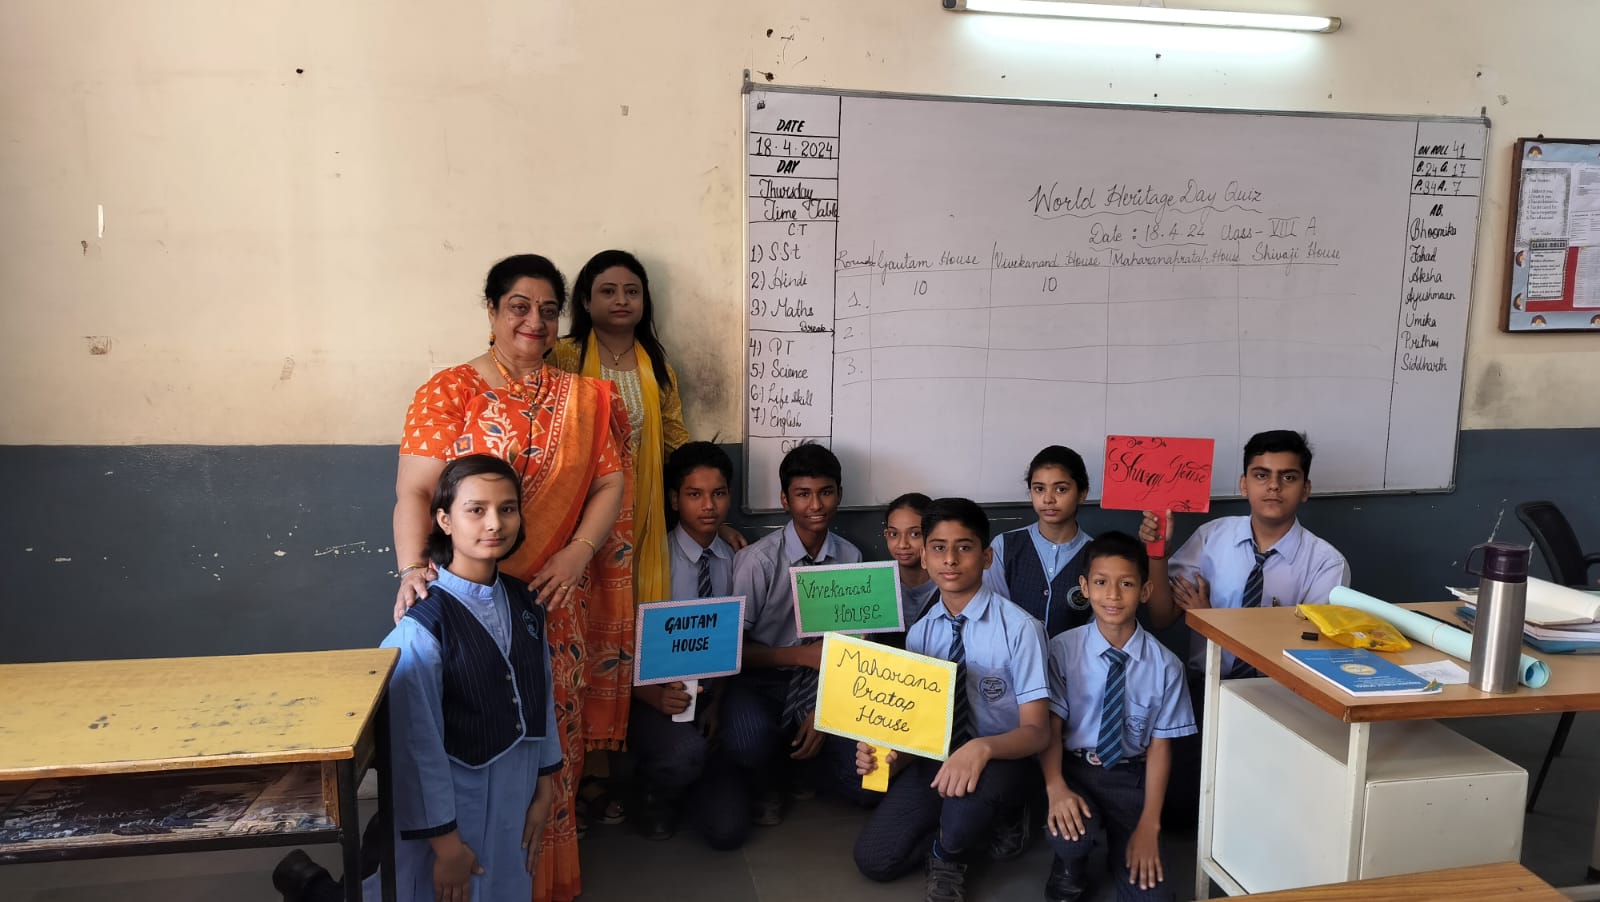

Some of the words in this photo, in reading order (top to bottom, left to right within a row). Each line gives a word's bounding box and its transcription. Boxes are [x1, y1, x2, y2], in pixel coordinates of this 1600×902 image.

[776, 119, 806, 133] DATE
[1418, 145, 1430, 155] ON
[1431, 145, 1449, 155] ROLL
[1453, 140, 1466, 159] 41
[776, 160, 800, 174] DAY
[1452, 163, 1466, 177] 17
[759, 178, 814, 207] Thursday
[1453, 181, 1462, 196] 7
[764, 199, 798, 221] Time
[808, 200, 839, 219] Table
[1028, 182, 1097, 214] World
[1104, 183, 1177, 225] Heritage
[1180, 179, 1217, 225] Day
[1224, 181, 1263, 202] Quiz
[1089, 222, 1123, 245] Date
[1268, 216, 1301, 239] VIII
[1305, 216, 1317, 236] A
[877, 250, 932, 286] Gautam
[939, 250, 980, 266] House
[995, 249, 1058, 269] Vivekanand
[1064, 252, 1101, 267] House
[1252, 242, 1299, 276] Shivaji
[1307, 241, 1341, 260] House
[768, 267, 808, 289] Hindi
[913, 279, 928, 296] 10
[1042, 276, 1058, 293] 10
[771, 297, 814, 317] Maths
[799, 321, 826, 333] Break
[1405, 312, 1437, 328] Umika
[771, 359, 809, 379] Science
[1401, 352, 1448, 372] Siddharth
[768, 383, 789, 409] Life
[769, 405, 802, 435] English
[798, 574, 872, 599] Vivekanand
[664, 612, 718, 635] GAUTAM
[671, 636, 709, 654] HOUSE
[837, 647, 942, 694] Maharana
[852, 676, 916, 712] Pratap
[855, 705, 910, 733] House
